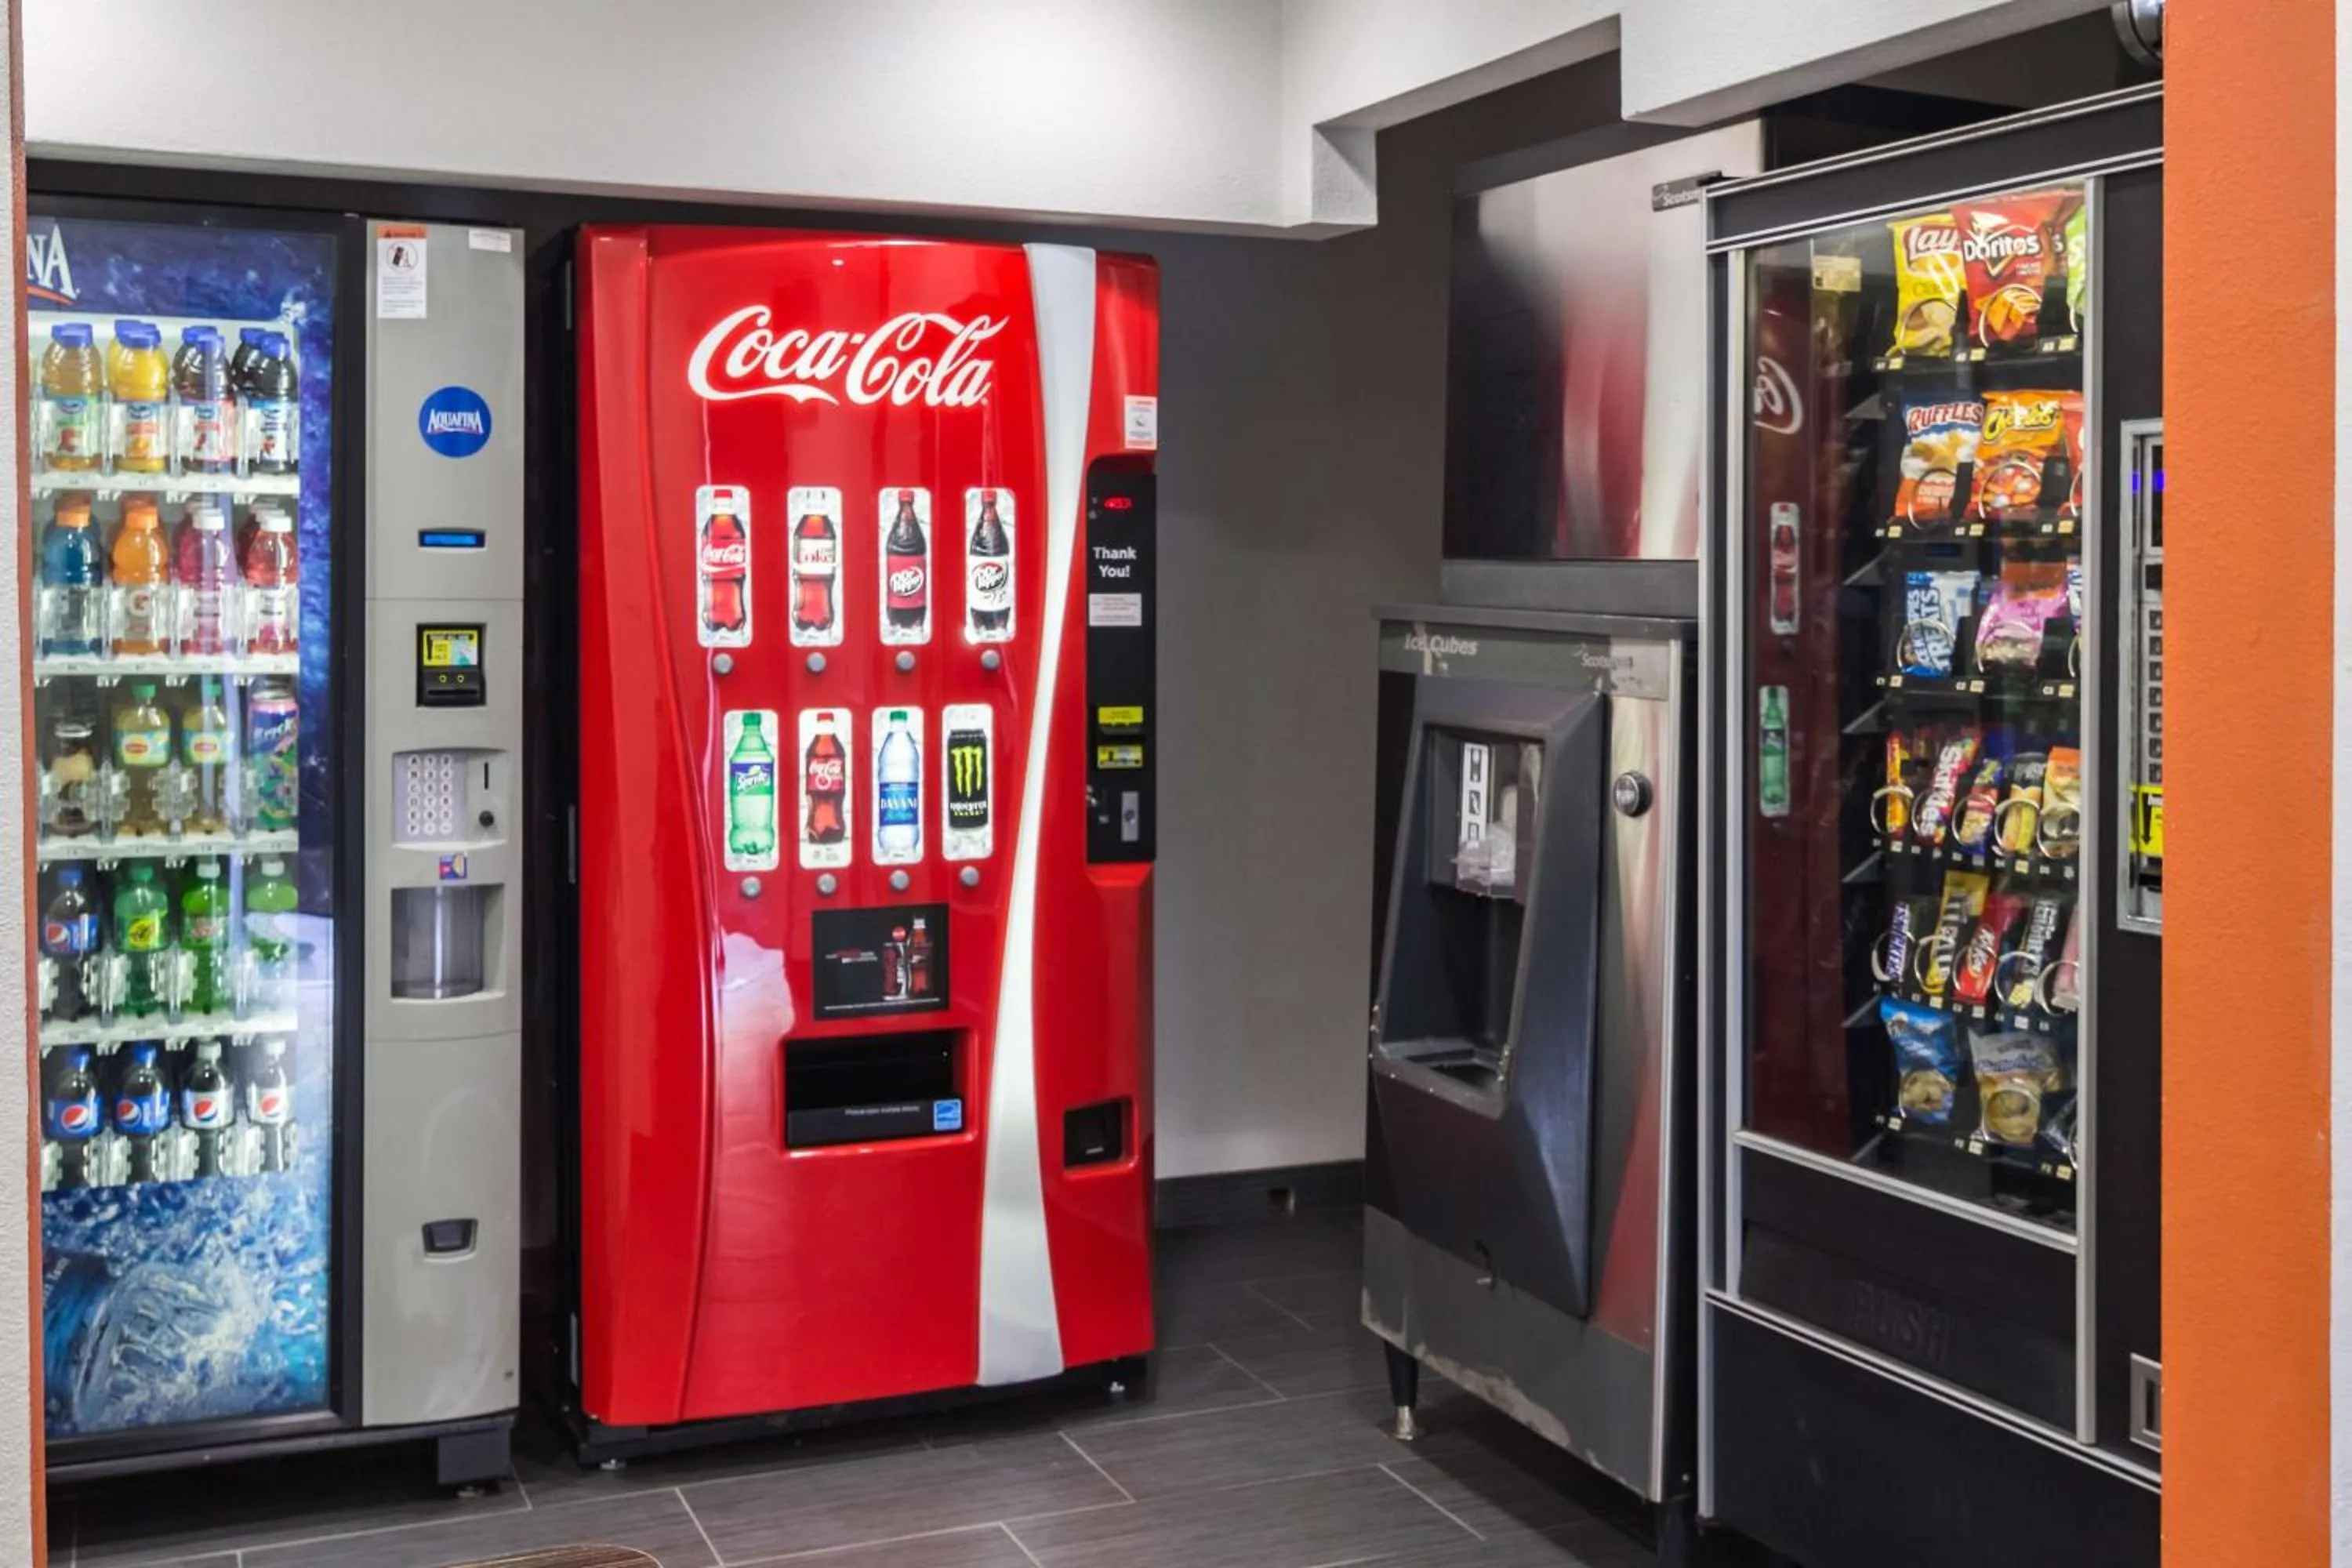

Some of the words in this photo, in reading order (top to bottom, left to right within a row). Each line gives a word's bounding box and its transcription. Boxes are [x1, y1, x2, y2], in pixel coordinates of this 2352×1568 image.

[1963, 233, 2040, 263] Doritos
[688, 305, 1011, 408] Coca-Cola
[426, 408, 484, 434] AQUAFINA
[1908, 402, 1984, 433] RUFFLES
[1093, 546, 1137, 560] Thank
[1099, 564, 1131, 578] You!
[1921, 587, 1952, 670] TREATS
